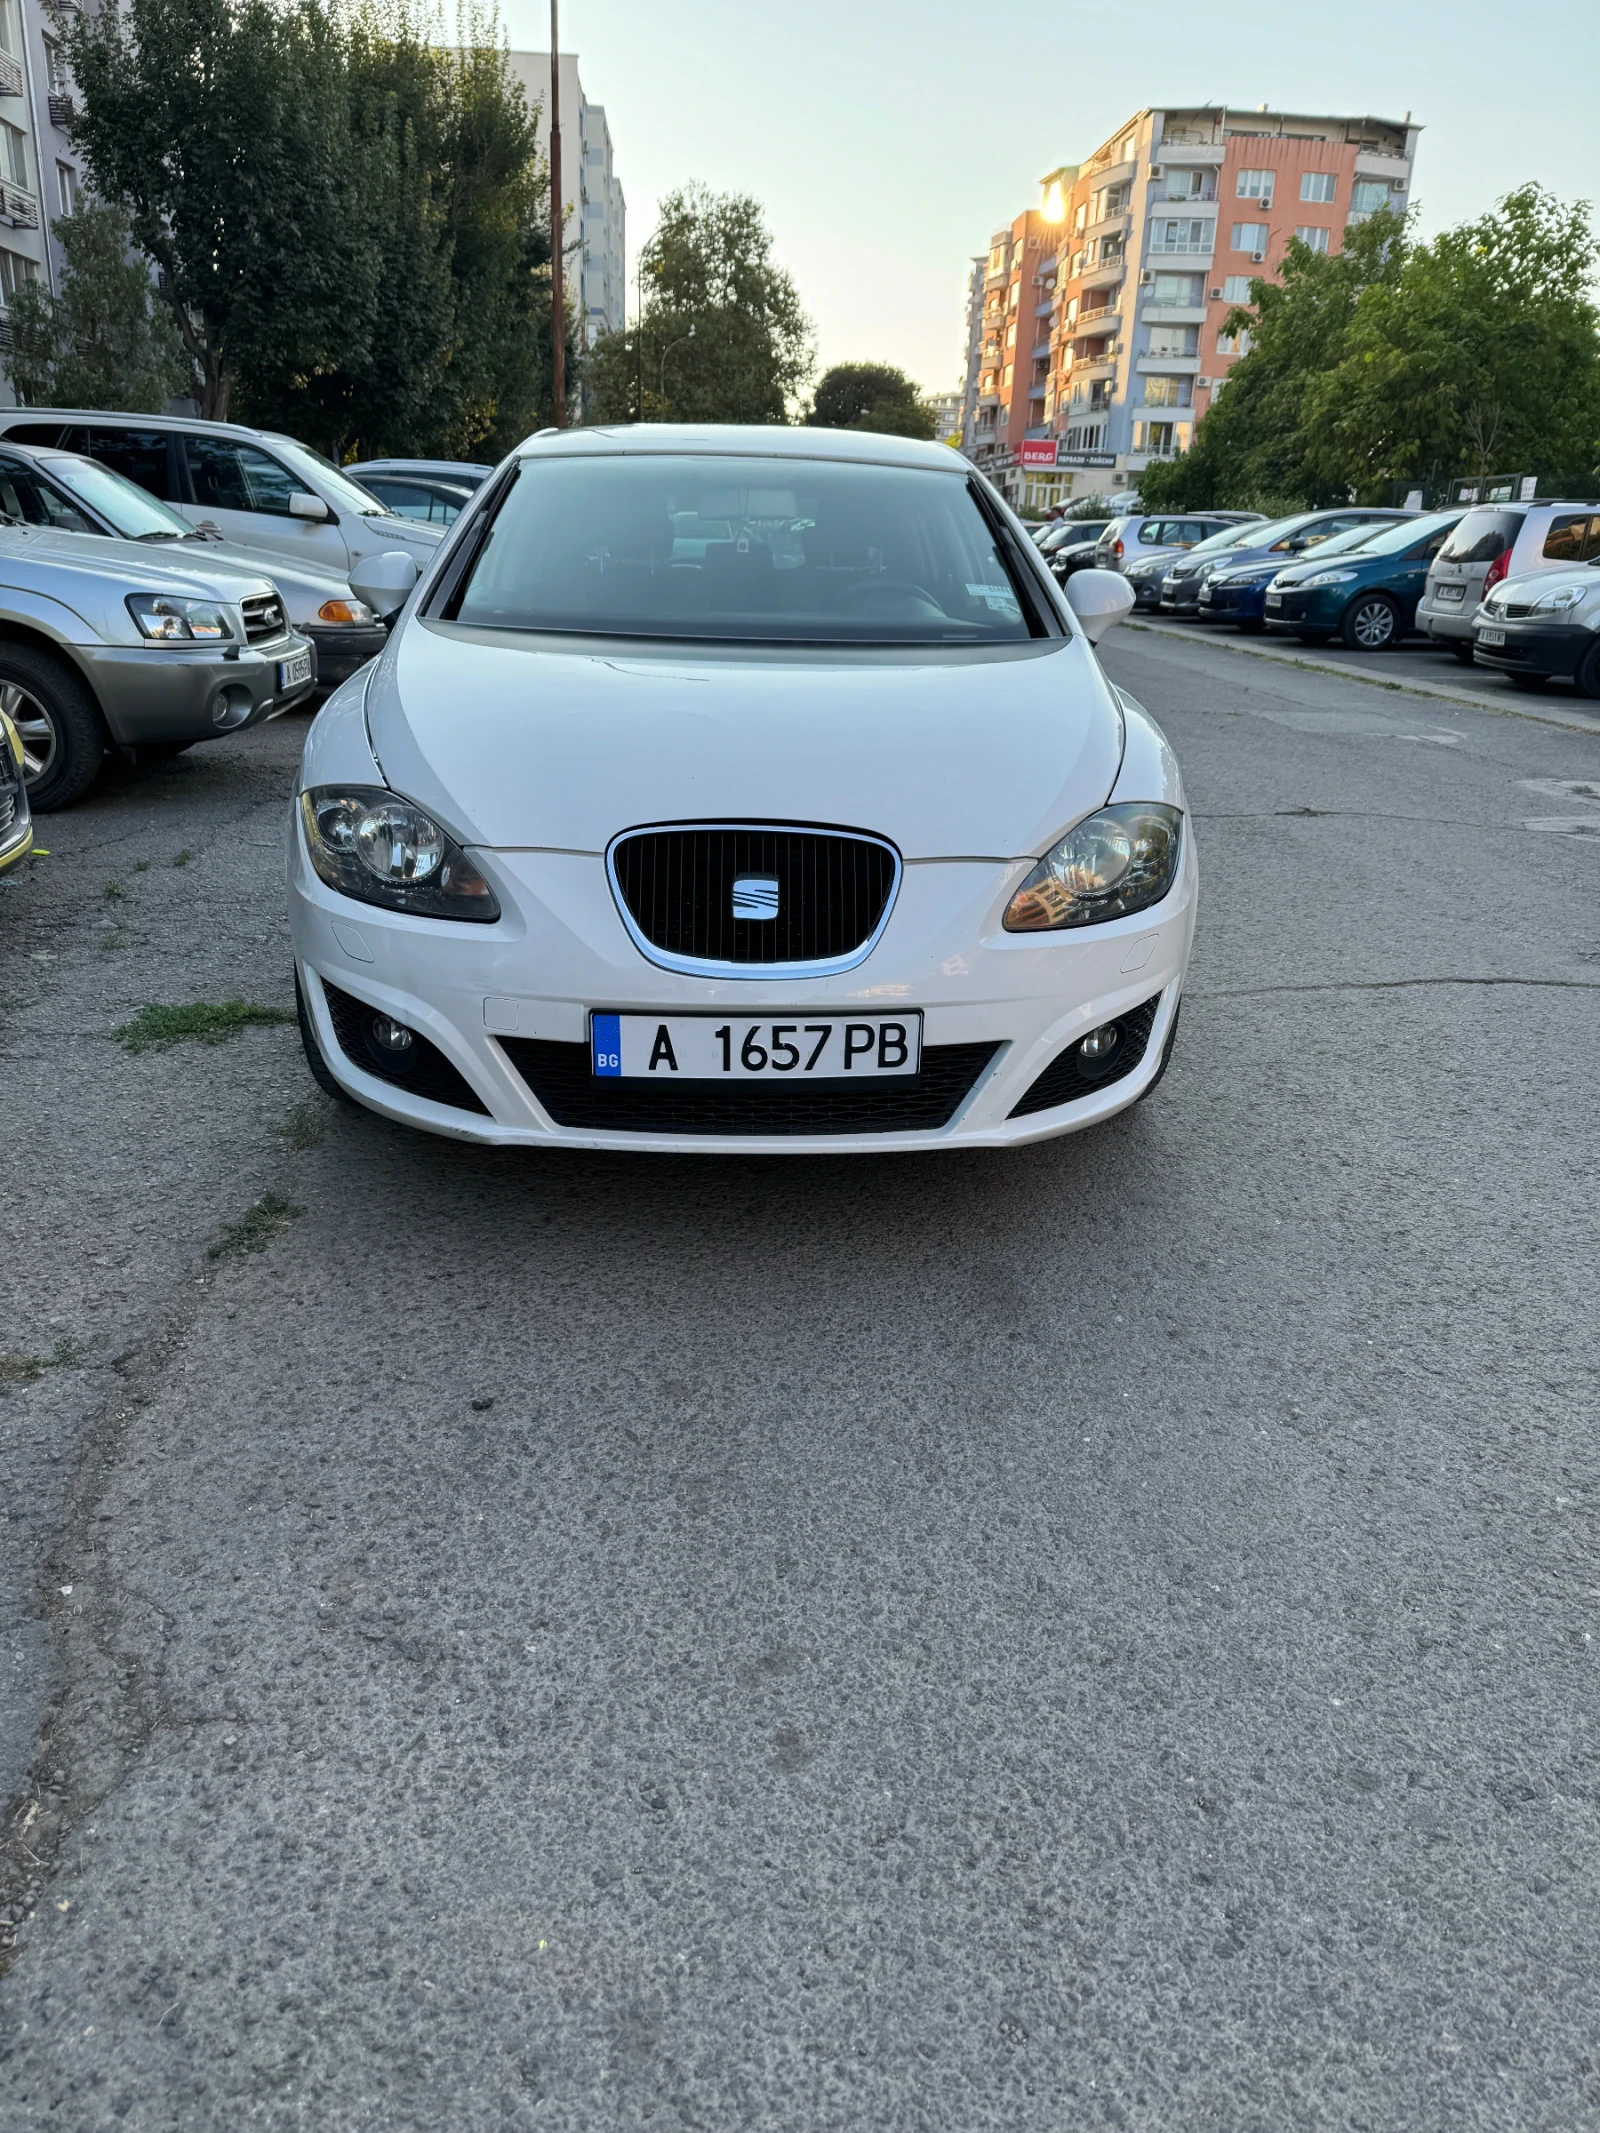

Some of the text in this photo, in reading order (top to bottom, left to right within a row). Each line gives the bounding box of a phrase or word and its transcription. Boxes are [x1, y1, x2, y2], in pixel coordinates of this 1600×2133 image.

[1024, 451, 1053, 461] BERG
[648, 1024, 679, 1071] A
[597, 1053, 619, 1067] BG
